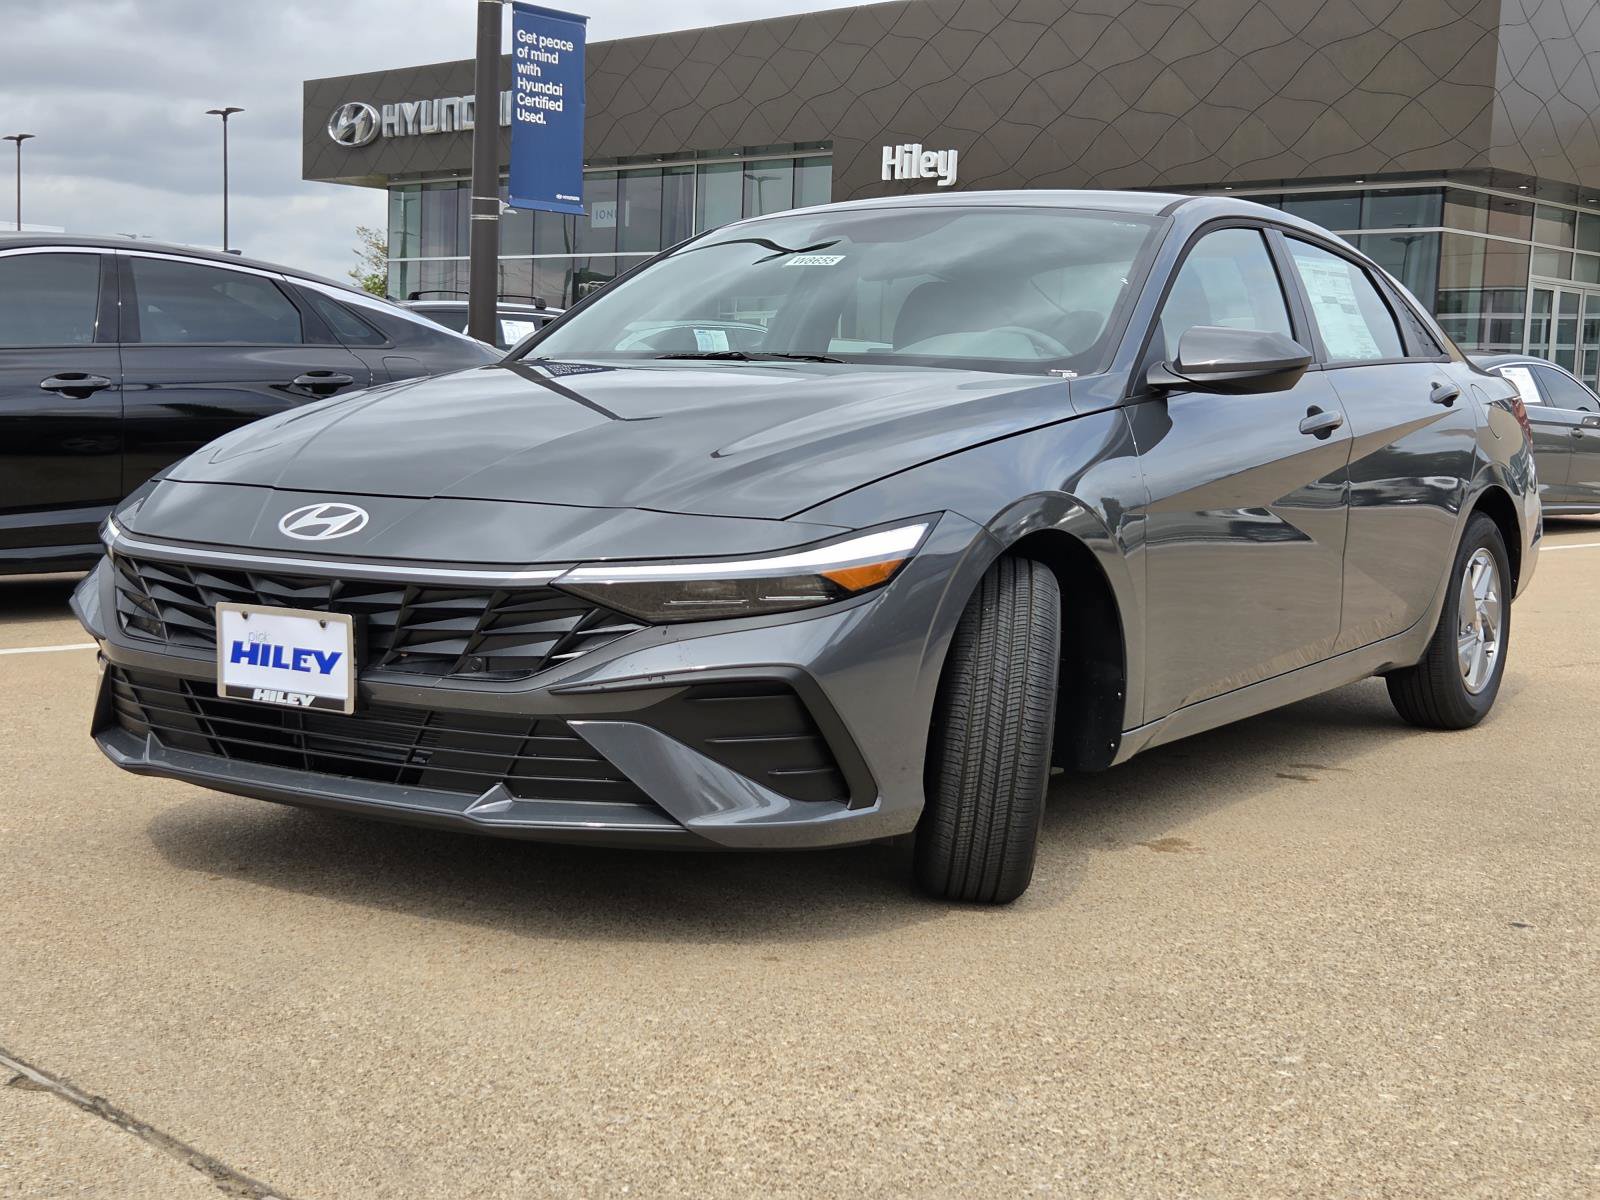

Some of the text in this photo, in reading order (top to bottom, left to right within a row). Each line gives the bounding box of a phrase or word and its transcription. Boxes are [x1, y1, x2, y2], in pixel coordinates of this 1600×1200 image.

[517, 29, 574, 51] Get peace
[517, 46, 559, 64] of mind
[516, 61, 541, 76] with
[517, 77, 563, 96] Hyundai
[517, 93, 563, 112] Certified
[516, 108, 547, 125] Used.
[881, 144, 958, 187] Hiley
[230, 640, 344, 675] HILEY
[253, 688, 316, 707] HILEY
